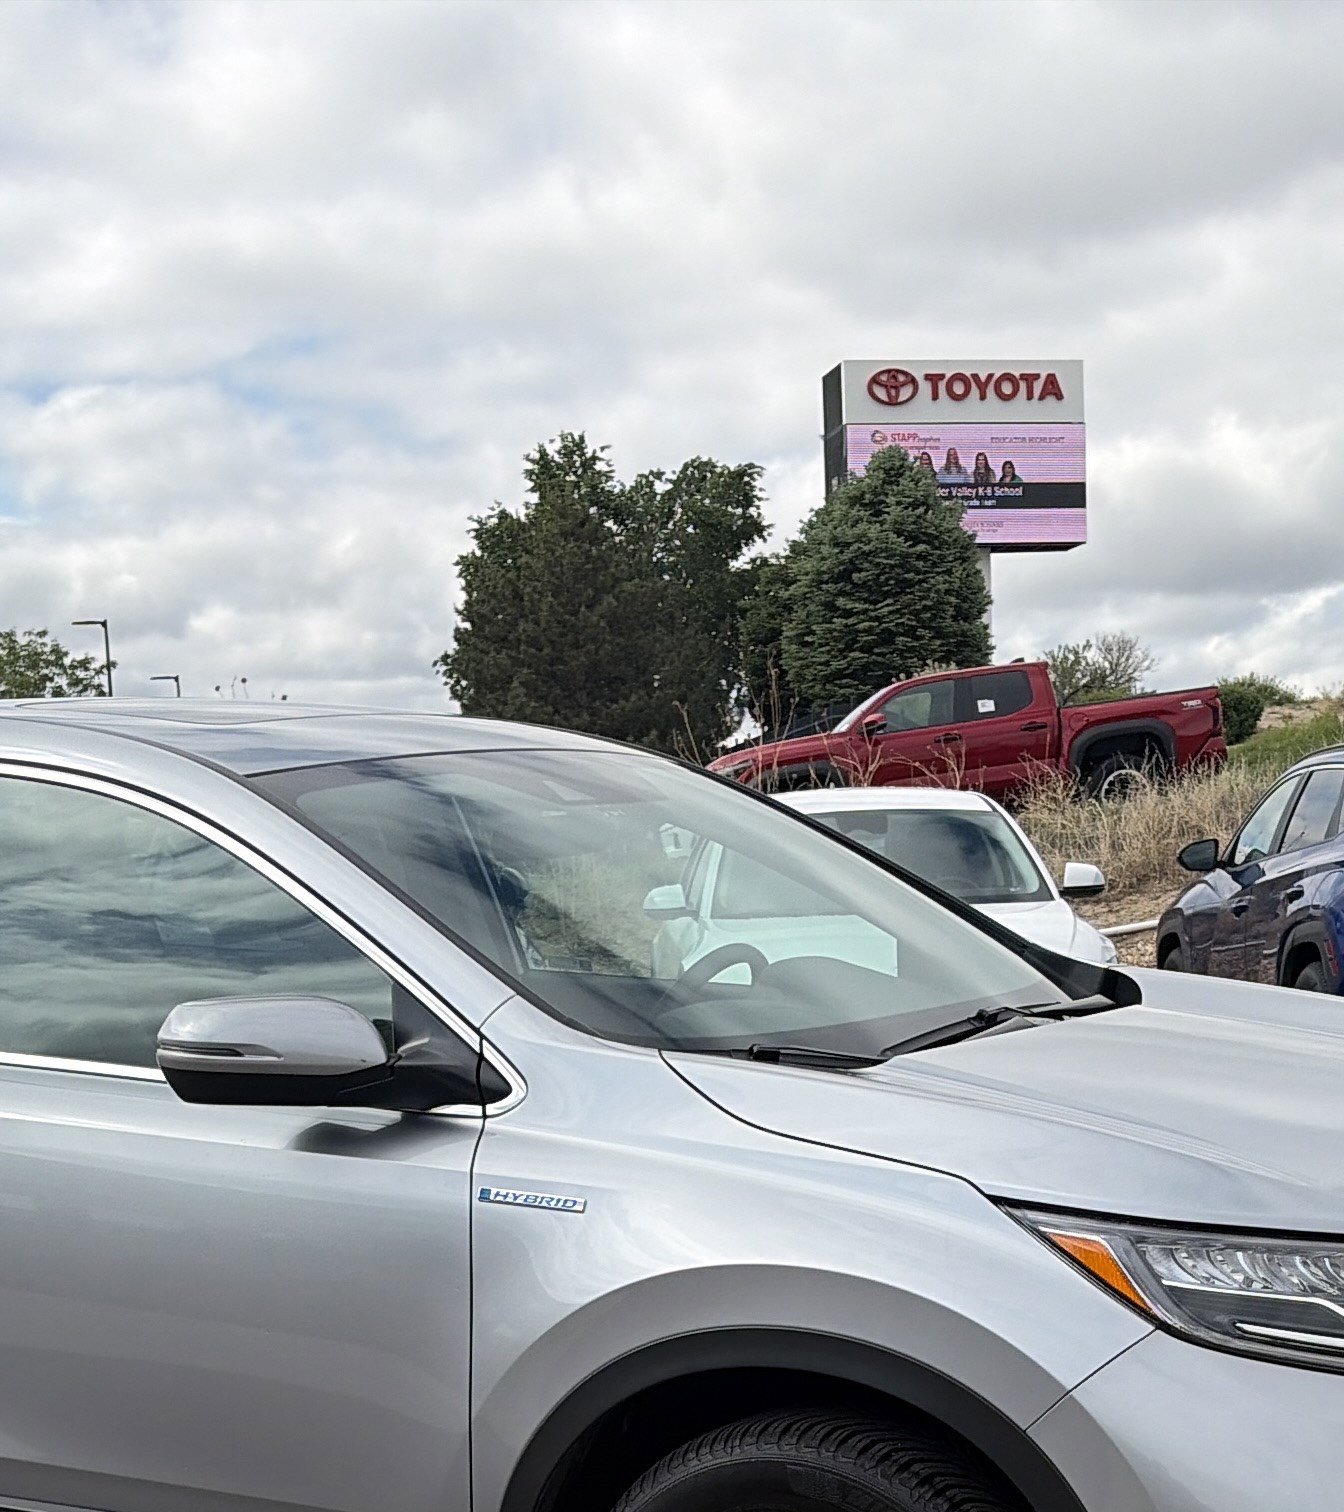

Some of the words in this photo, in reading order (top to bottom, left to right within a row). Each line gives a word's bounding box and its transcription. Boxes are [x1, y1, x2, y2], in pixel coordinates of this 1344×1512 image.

[924, 372, 1064, 402] TOYOTA
[950, 486, 977, 498] Valley
[993, 486, 1023, 497] School
[493, 1190, 578, 1209] HYBRID
